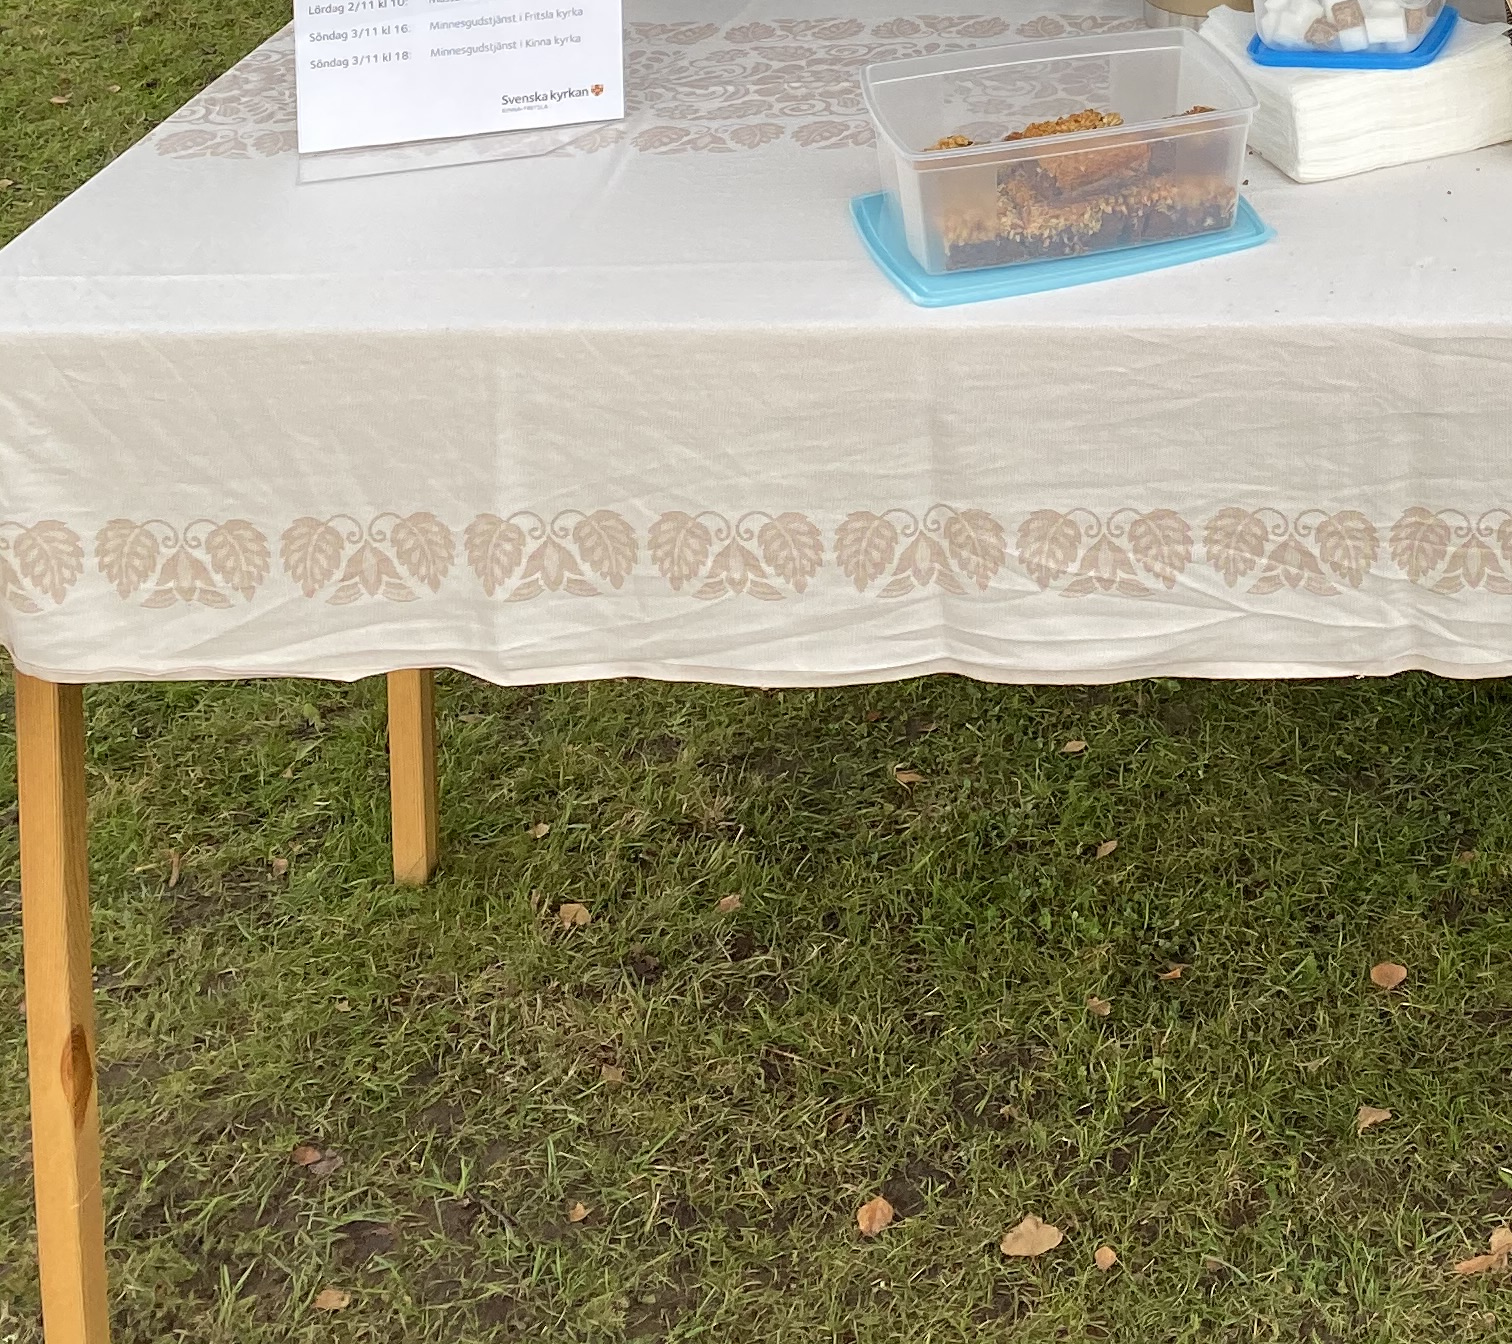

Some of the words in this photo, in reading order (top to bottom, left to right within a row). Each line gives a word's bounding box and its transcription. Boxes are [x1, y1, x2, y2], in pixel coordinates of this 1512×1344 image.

[308, 3, 345, 15] Lördag
[347, 0, 374, 12] 2/11
[429, 14, 516, 30] Minnesgudstjänst
[524, 10, 554, 21] Fritsla
[556, 7, 584, 20] kyrka
[309, 31, 348, 42] Söndag
[351, 27, 378, 39] 3/11
[381, 25, 391, 35] kl
[430, 41, 517, 57] Minnesgudstjänst
[525, 38, 552, 48] Kinna
[554, 34, 581, 47] kyrka
[310, 57, 349, 69] Söndag
[352, 53, 378, 66] 3/11
[382, 52, 392, 62] kl
[501, 91, 548, 106] Svenska
[549, 87, 589, 102] kyrkan
